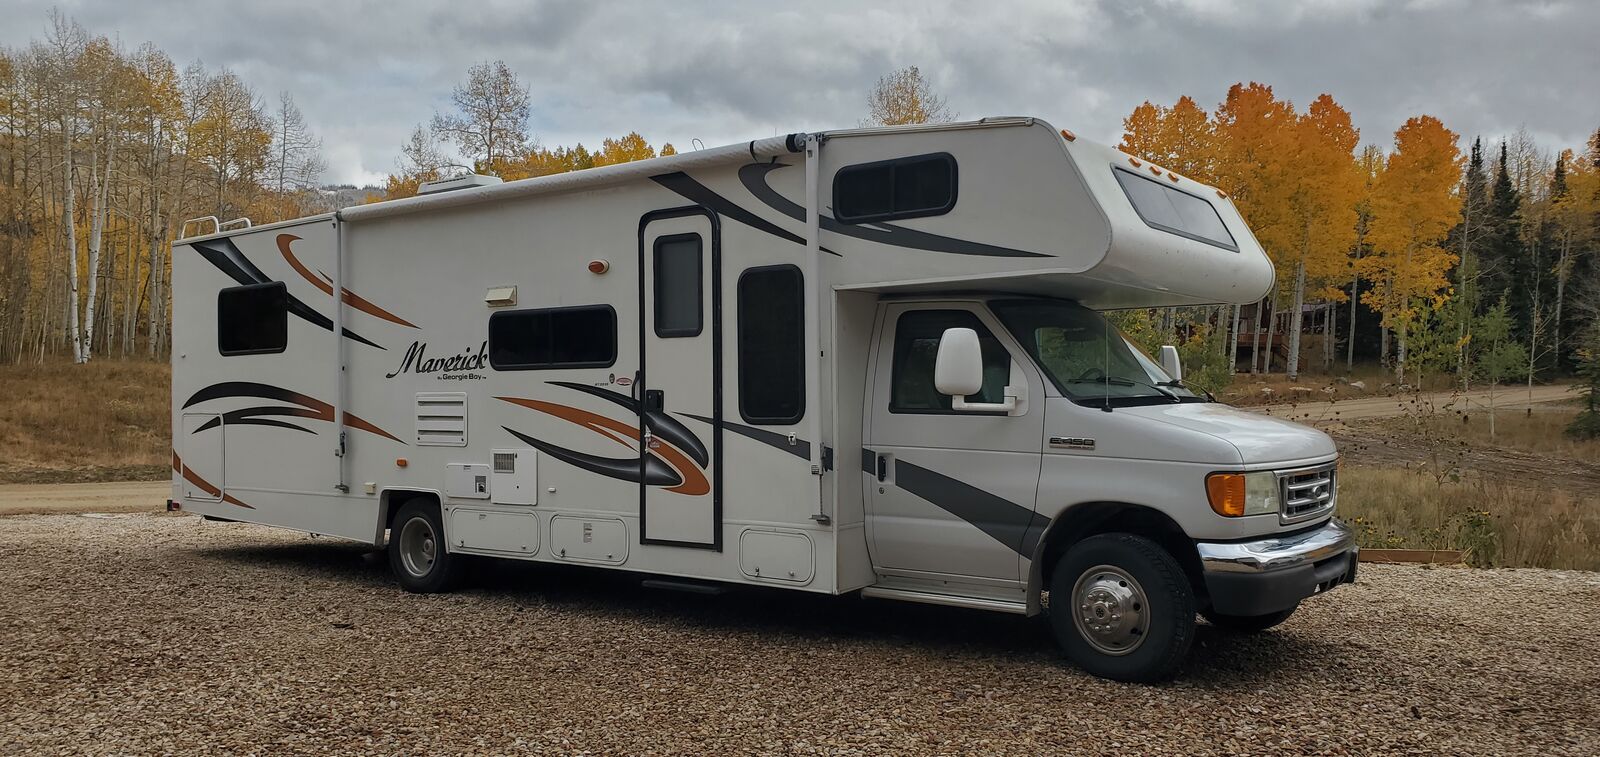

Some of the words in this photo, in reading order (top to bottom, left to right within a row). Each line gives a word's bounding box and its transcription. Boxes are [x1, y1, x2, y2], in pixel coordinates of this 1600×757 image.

[386, 340, 488, 378] Maverick
[442, 373, 468, 381] Georgie
[468, 373, 481, 381] Boy
